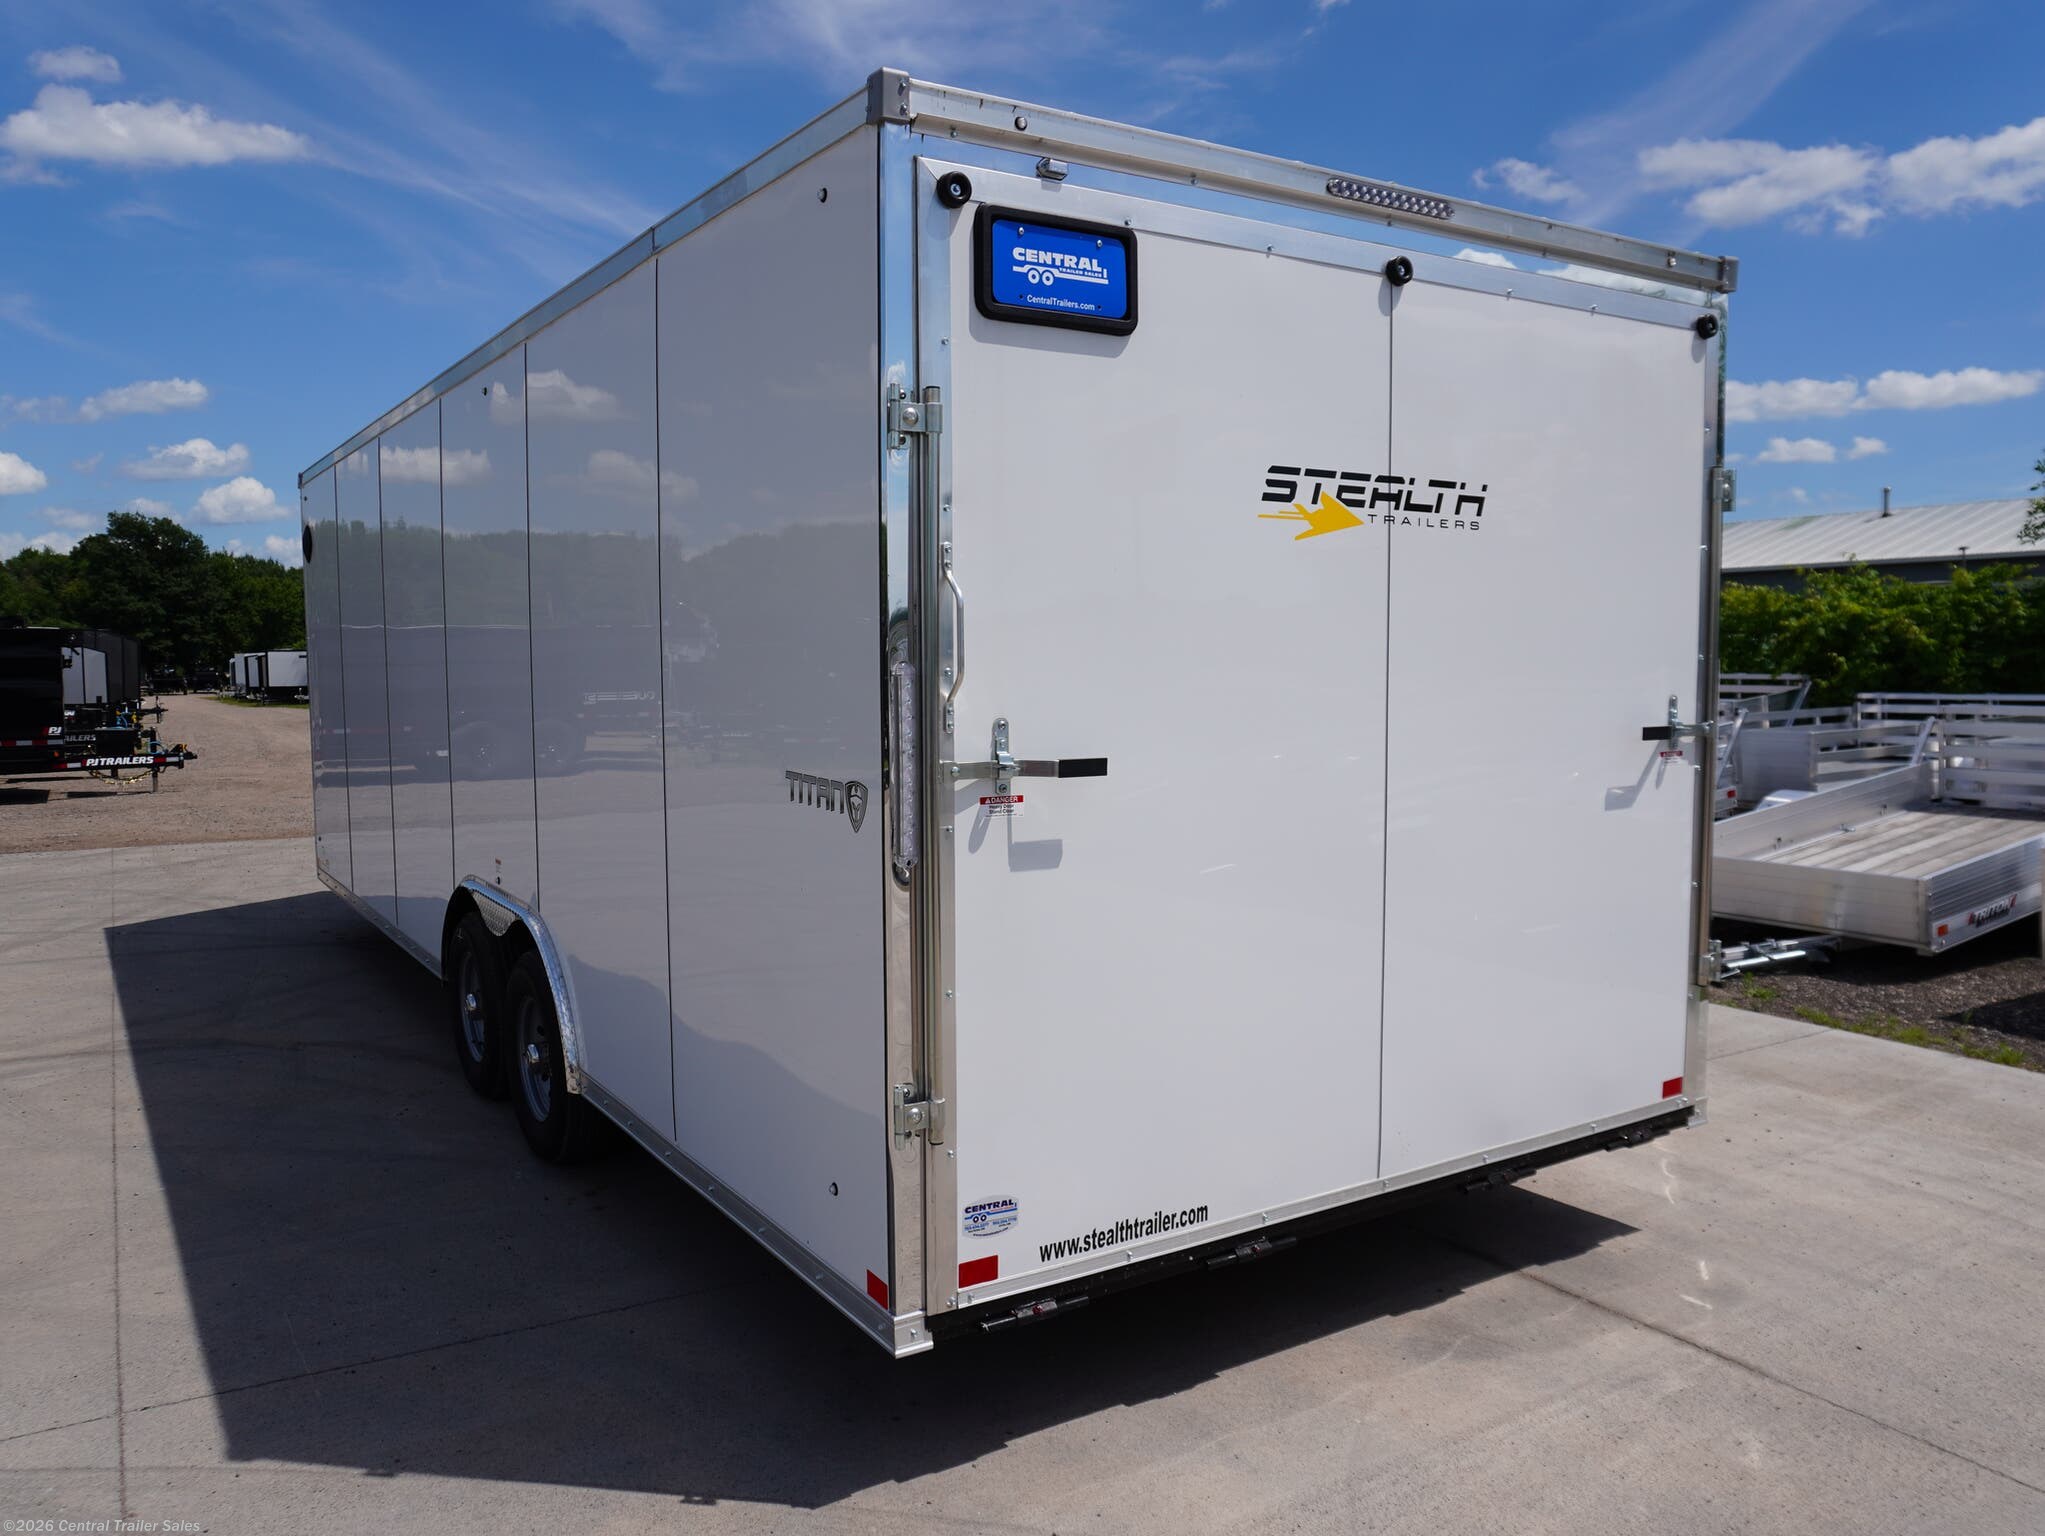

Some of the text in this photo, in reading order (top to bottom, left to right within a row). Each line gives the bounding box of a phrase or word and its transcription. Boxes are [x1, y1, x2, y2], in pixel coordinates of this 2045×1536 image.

[1012, 246, 1102, 273] CENTRAL
[1026, 294, 1095, 311] CentralTrailers.com
[1261, 465, 1489, 517] STEALTH
[1367, 514, 1481, 531] TRAILERS
[48, 726, 62, 734] PJ
[99, 756, 154, 766] TRAILERS
[785, 770, 845, 814] TITAN
[990, 796, 1018, 804] DANGER
[964, 1199, 1014, 1214] CENTRAL
[1039, 1205, 1209, 1263] www.stealthtrailer.com
